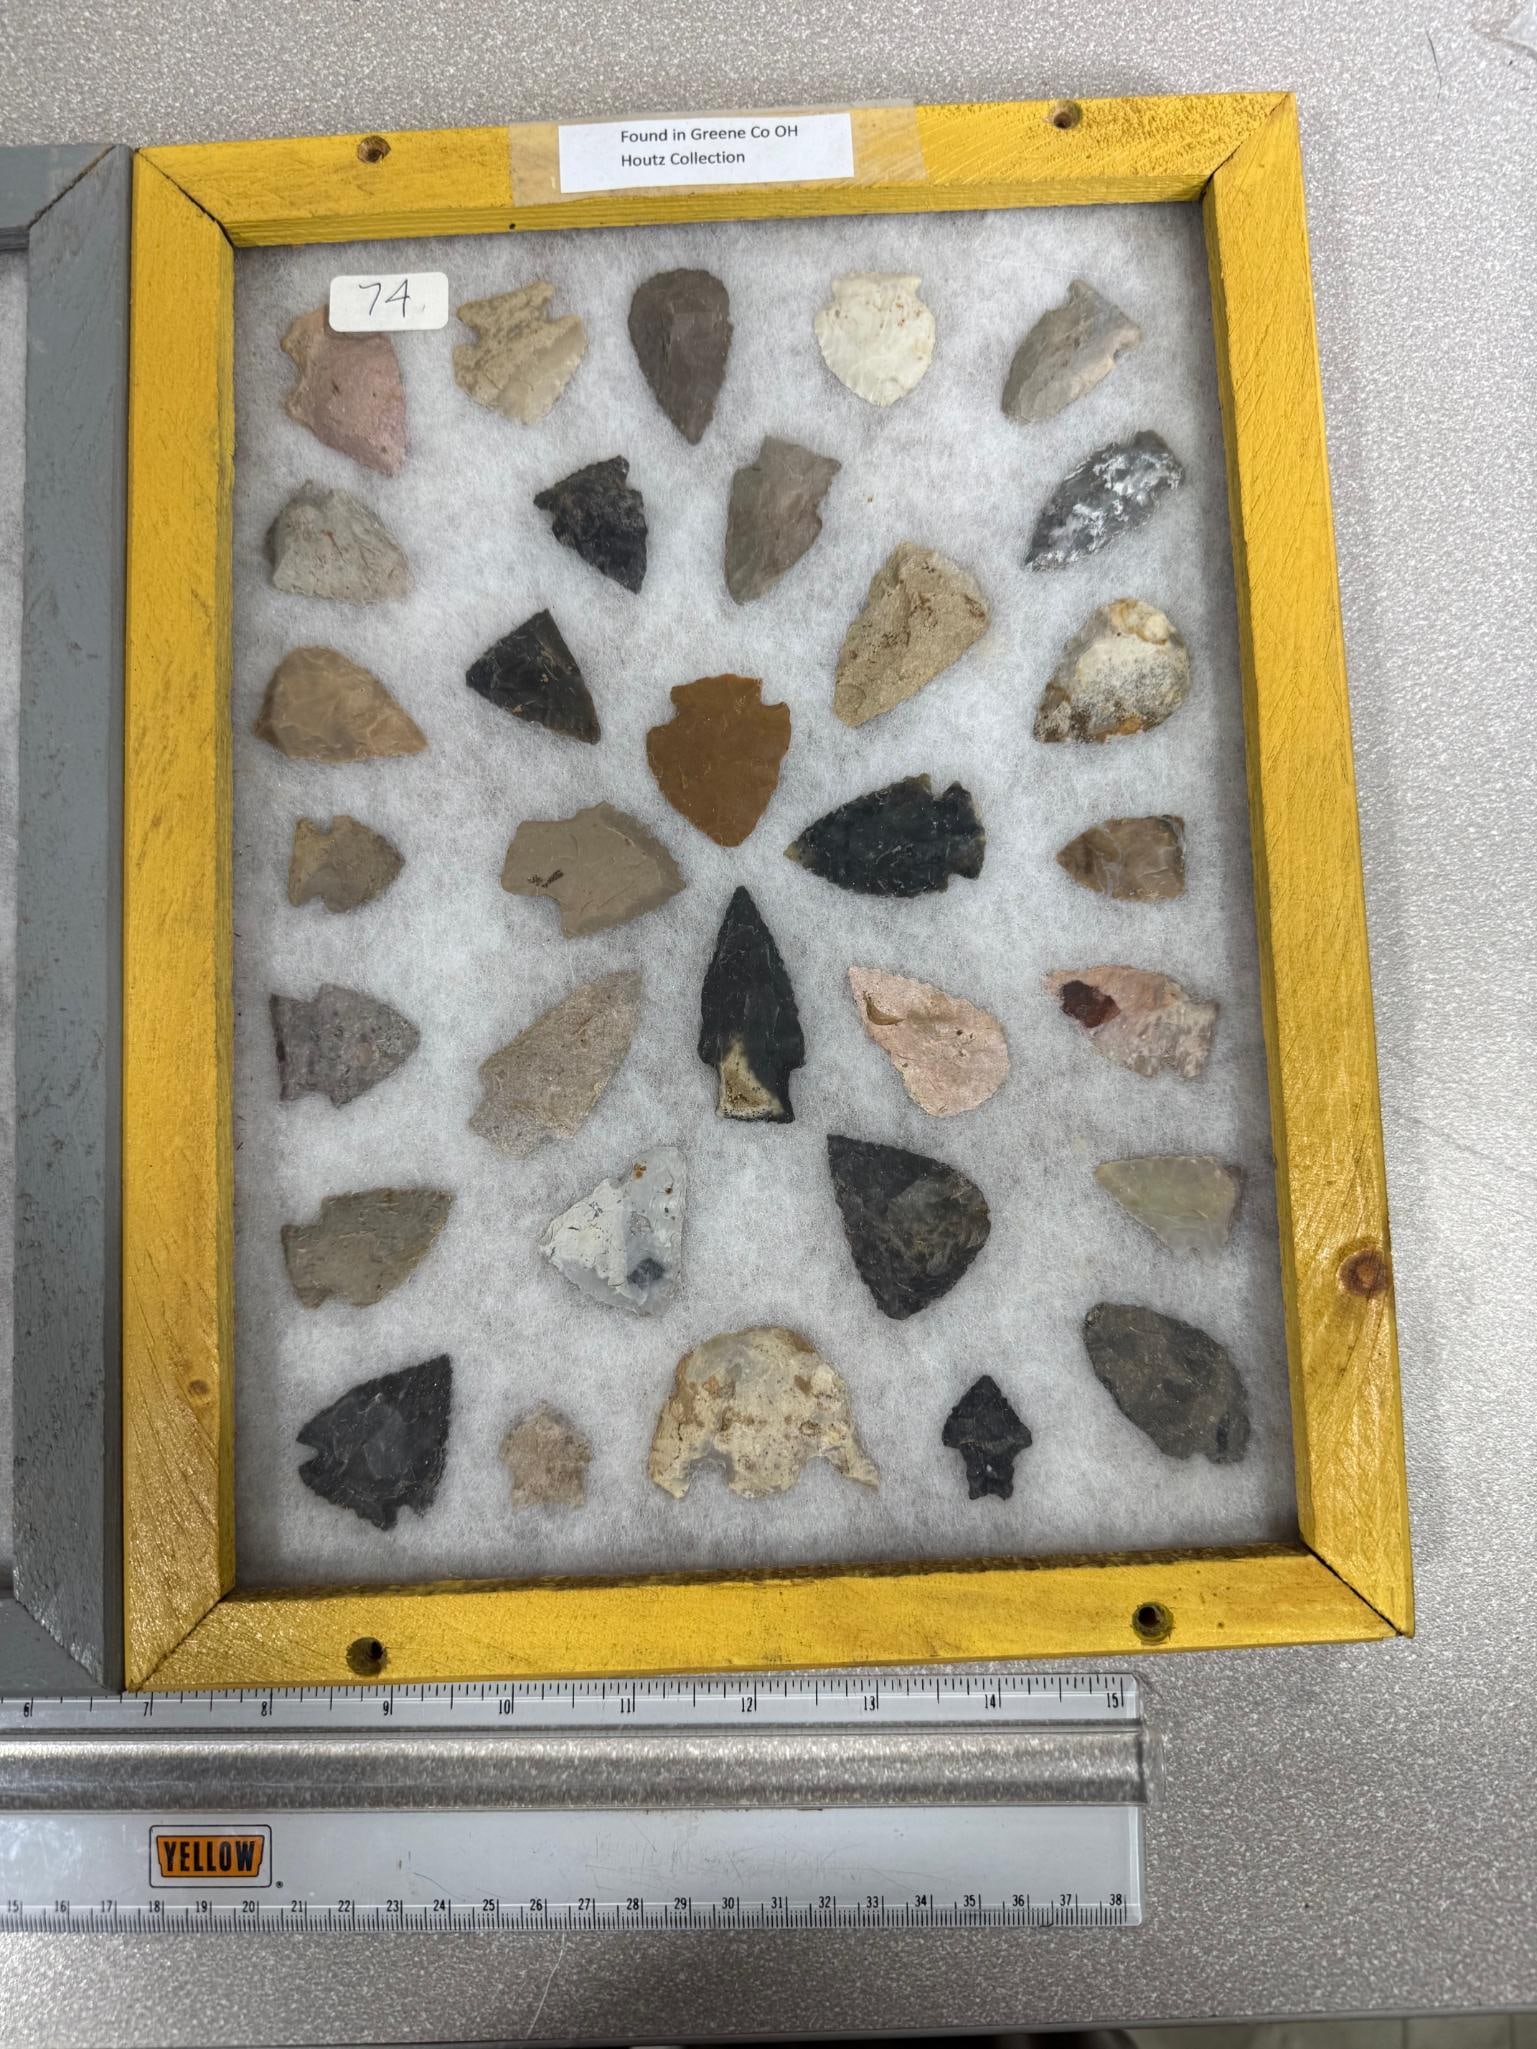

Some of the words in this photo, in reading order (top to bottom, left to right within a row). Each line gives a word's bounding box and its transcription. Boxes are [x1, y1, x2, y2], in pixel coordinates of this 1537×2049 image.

[620, 129, 668, 143] Found
[673, 128, 686, 141] in
[690, 127, 746, 141] Greene
[750, 126, 771, 139] Co
[774, 124, 799, 138] OH
[620, 153, 666, 167] Houtz
[670, 151, 746, 166] Collection
[358, 278, 411, 318] 74
[23, 1702, 30, 1718] 6
[143, 1701, 149, 1716] 7
[260, 1701, 268, 1716] 8
[383, 1700, 389, 1716] 9
[498, 1699, 511, 1715] 10
[620, 1697, 631, 1713] 11
[741, 1696, 753, 1713] 12
[863, 1695, 875, 1711] 13
[984, 1693, 996, 1709] 14
[1107, 1692, 1119, 1708] 15
[163, 1840, 256, 1872] YELLOW
[7, 1901, 19, 1912] 15
[54, 1901, 67, 1912] 16
[100, 1901, 113, 1912] 17
[149, 1901, 161, 1912] 18
[195, 1901, 208, 1912] 19
[242, 1900, 255, 1912] 20
[291, 1900, 303, 1912] 21
[338, 1900, 350, 1912] 22
[386, 1900, 399, 1912] 23
[433, 1899, 446, 1911] 24
[482, 1899, 495, 1911] 25
[529, 1899, 543, 1911] 26
[578, 1898, 591, 1911] 27
[626, 1898, 639, 1910] 28
[674, 1897, 687, 1910] 29
[722, 1897, 735, 1909] 30
[771, 1896, 783, 1909] 31
[819, 1896, 831, 1909] 32
[866, 1895, 879, 1908] 33
[914, 1894, 927, 1907] 34
[963, 1894, 976, 1907] 35
[1012, 1894, 1025, 1907] 36
[1059, 1894, 1072, 1906] 37
[1109, 1893, 1122, 1906] 38
